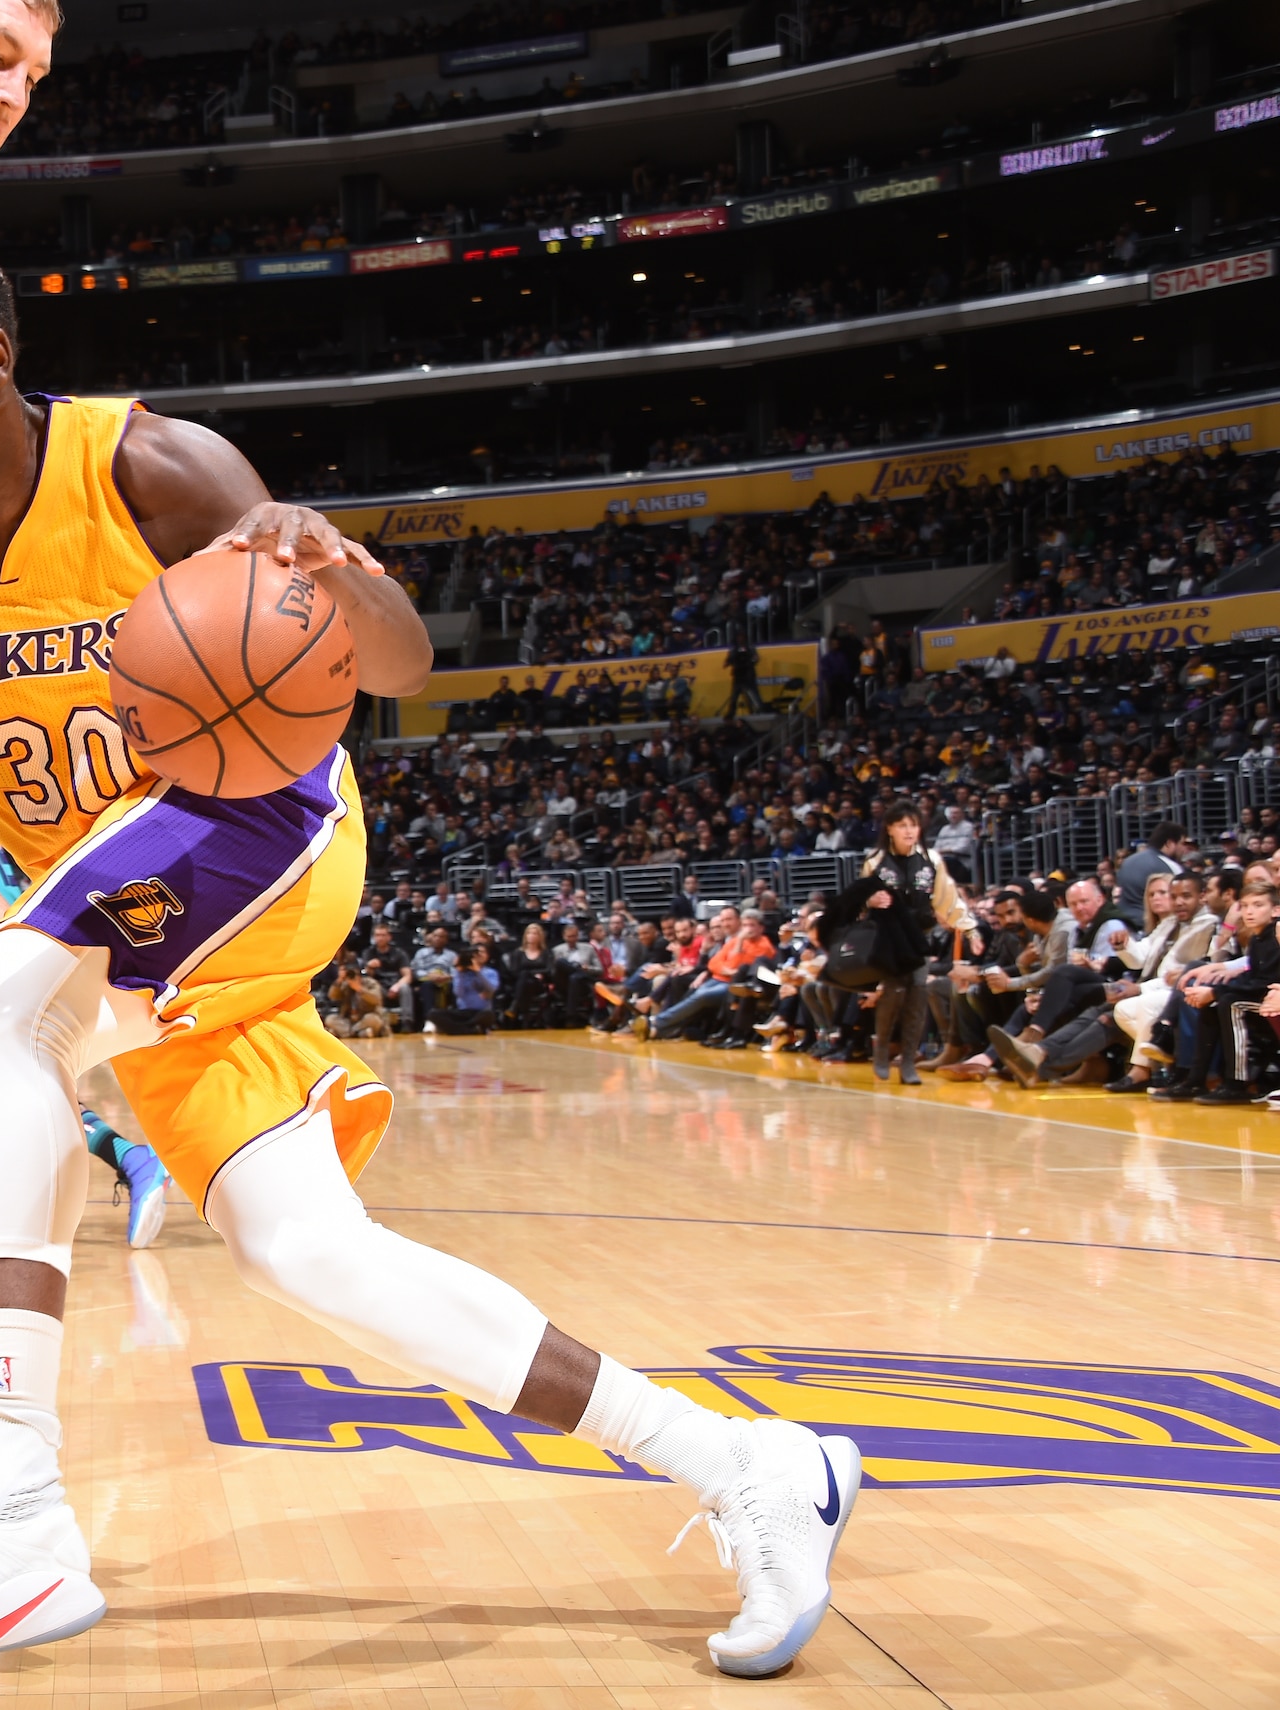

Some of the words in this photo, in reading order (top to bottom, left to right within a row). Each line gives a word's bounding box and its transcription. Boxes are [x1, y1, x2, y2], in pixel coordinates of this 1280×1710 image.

[853, 176, 941, 205] verizon
[741, 193, 830, 224] StubHub
[351, 244, 450, 271] TOSHIBA
[1154, 253, 1272, 298] STAPLES
[376, 510, 465, 541] LAKERS
[1075, 615, 1110, 631] LOS
[1114, 606, 1210, 627] ANGELES
